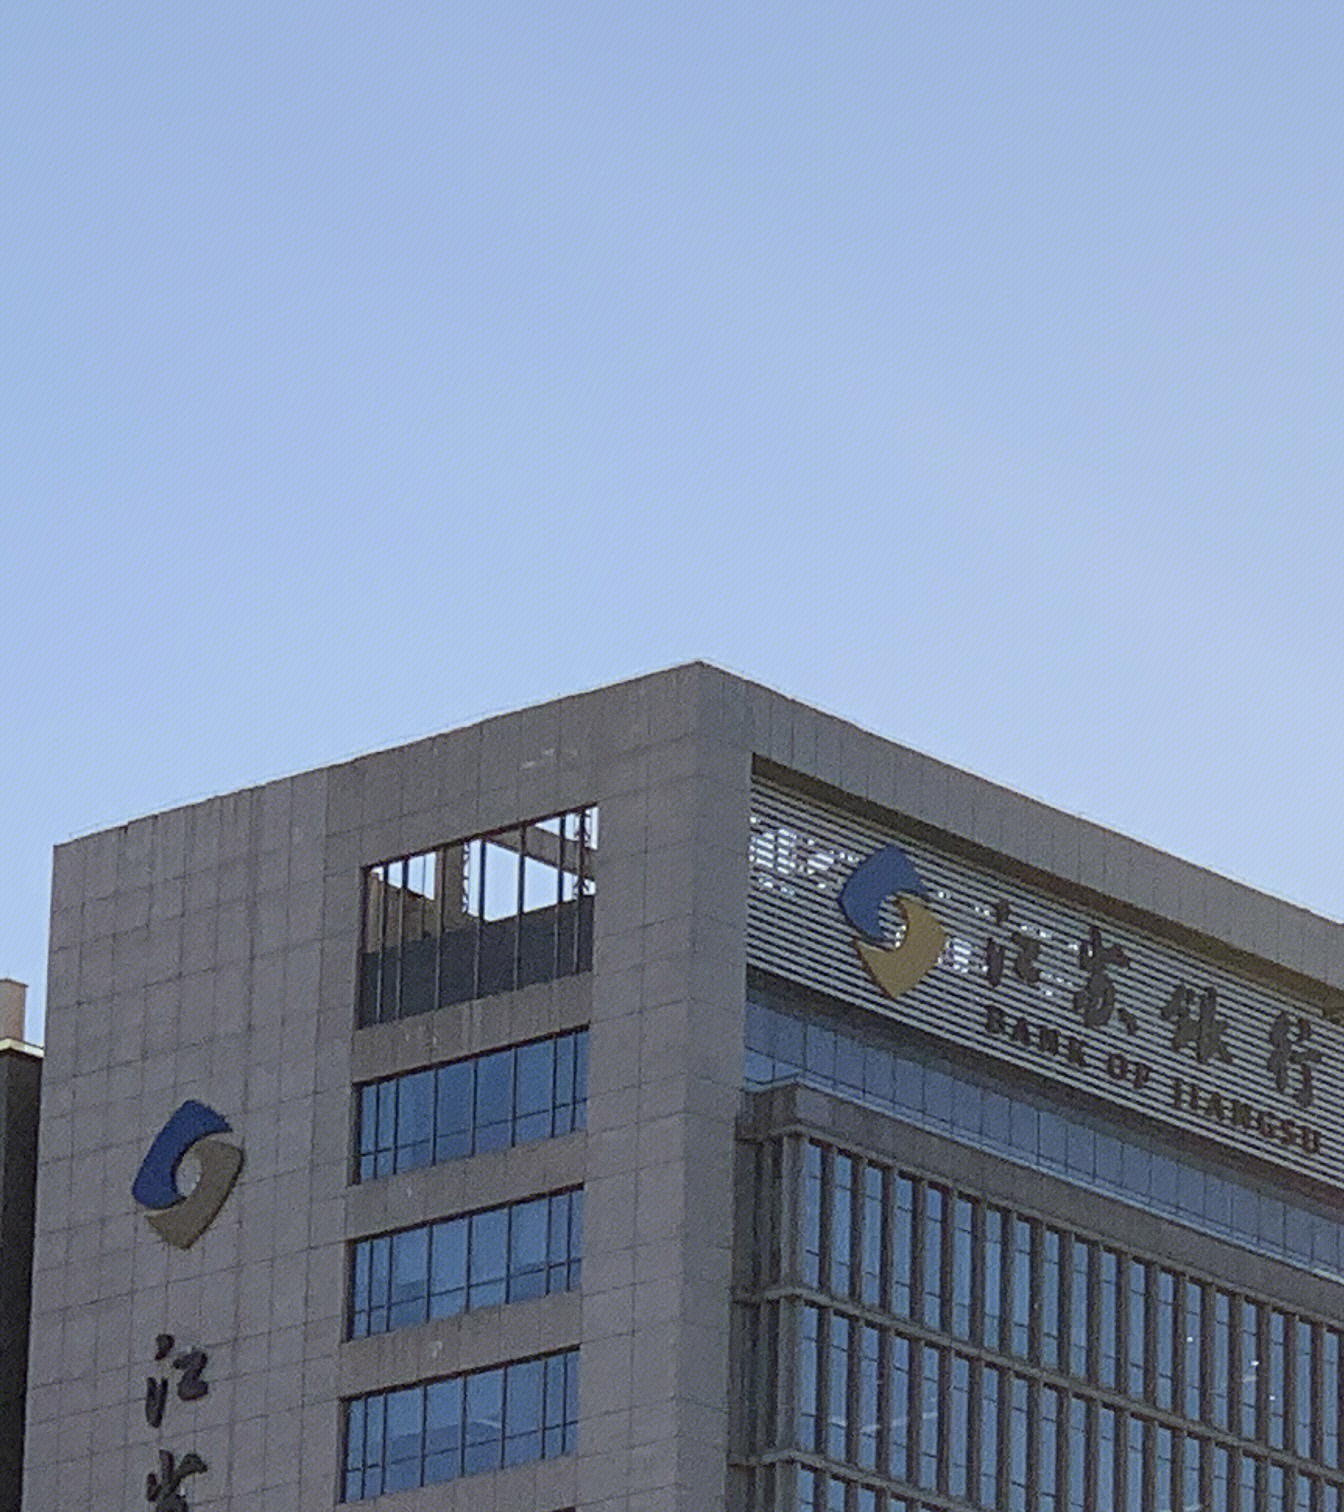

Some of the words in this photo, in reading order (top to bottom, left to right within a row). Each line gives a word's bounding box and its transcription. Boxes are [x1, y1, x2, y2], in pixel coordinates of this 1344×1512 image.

[984, 899, 1323, 1109] 江苏银行
[985, 1005, 1088, 1067] BANK
[1105, 1052, 1151, 1091] OF
[1173, 1075, 1322, 1154] JIANGSU
